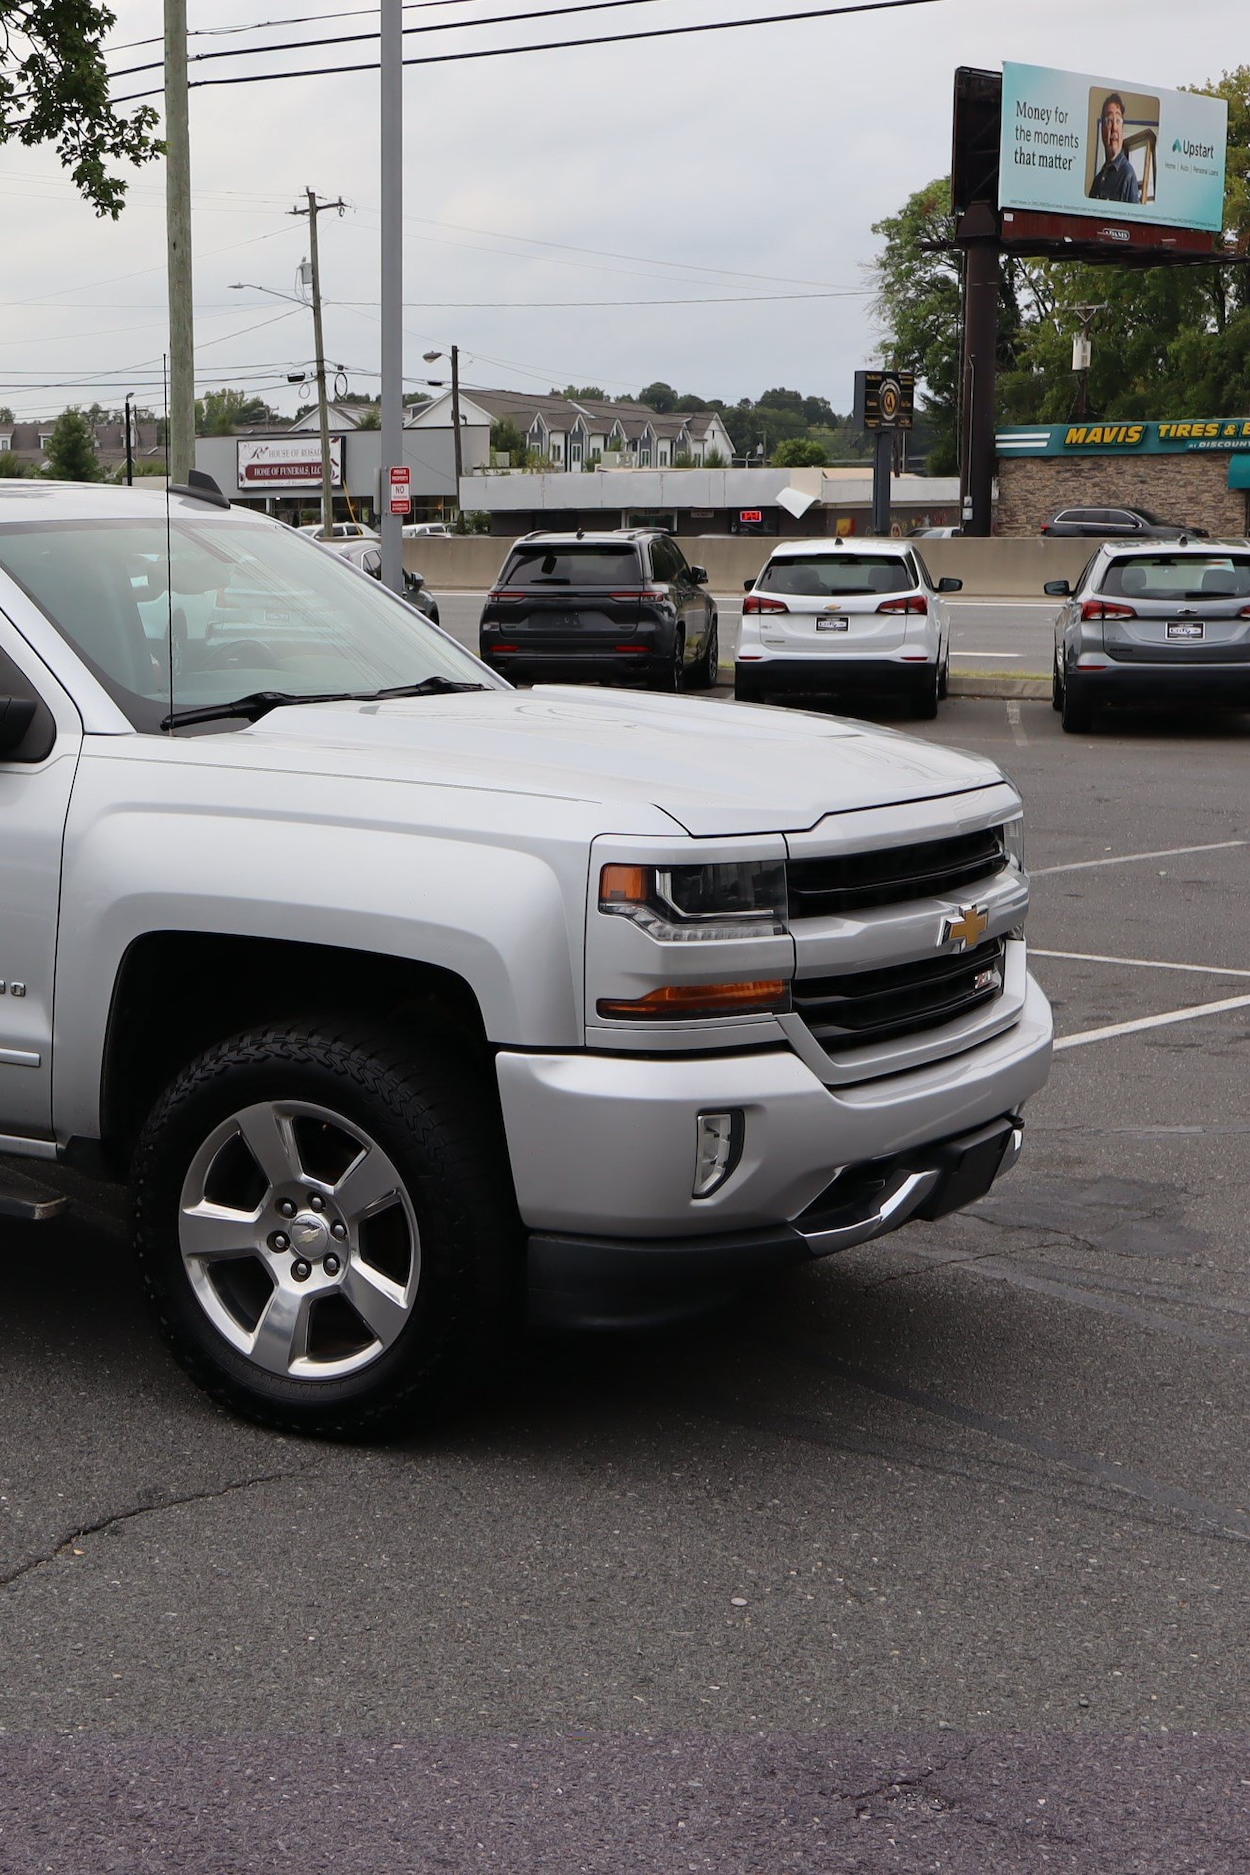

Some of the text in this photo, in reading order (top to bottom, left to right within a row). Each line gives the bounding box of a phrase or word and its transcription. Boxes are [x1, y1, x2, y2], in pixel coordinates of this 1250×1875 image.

[1016, 100, 1069, 126] Money for
[1015, 124, 1079, 149] the moments
[1014, 146, 1036, 166] that
[1183, 139, 1214, 159] Upstart
[1064, 425, 1144, 445] MAVIS
[1158, 423, 1220, 438] TIRES
[1223, 424, 1236, 436] &
[254, 467, 271, 476] HOME
[271, 467, 279, 476] OF
[395, 485, 405, 495] NO
